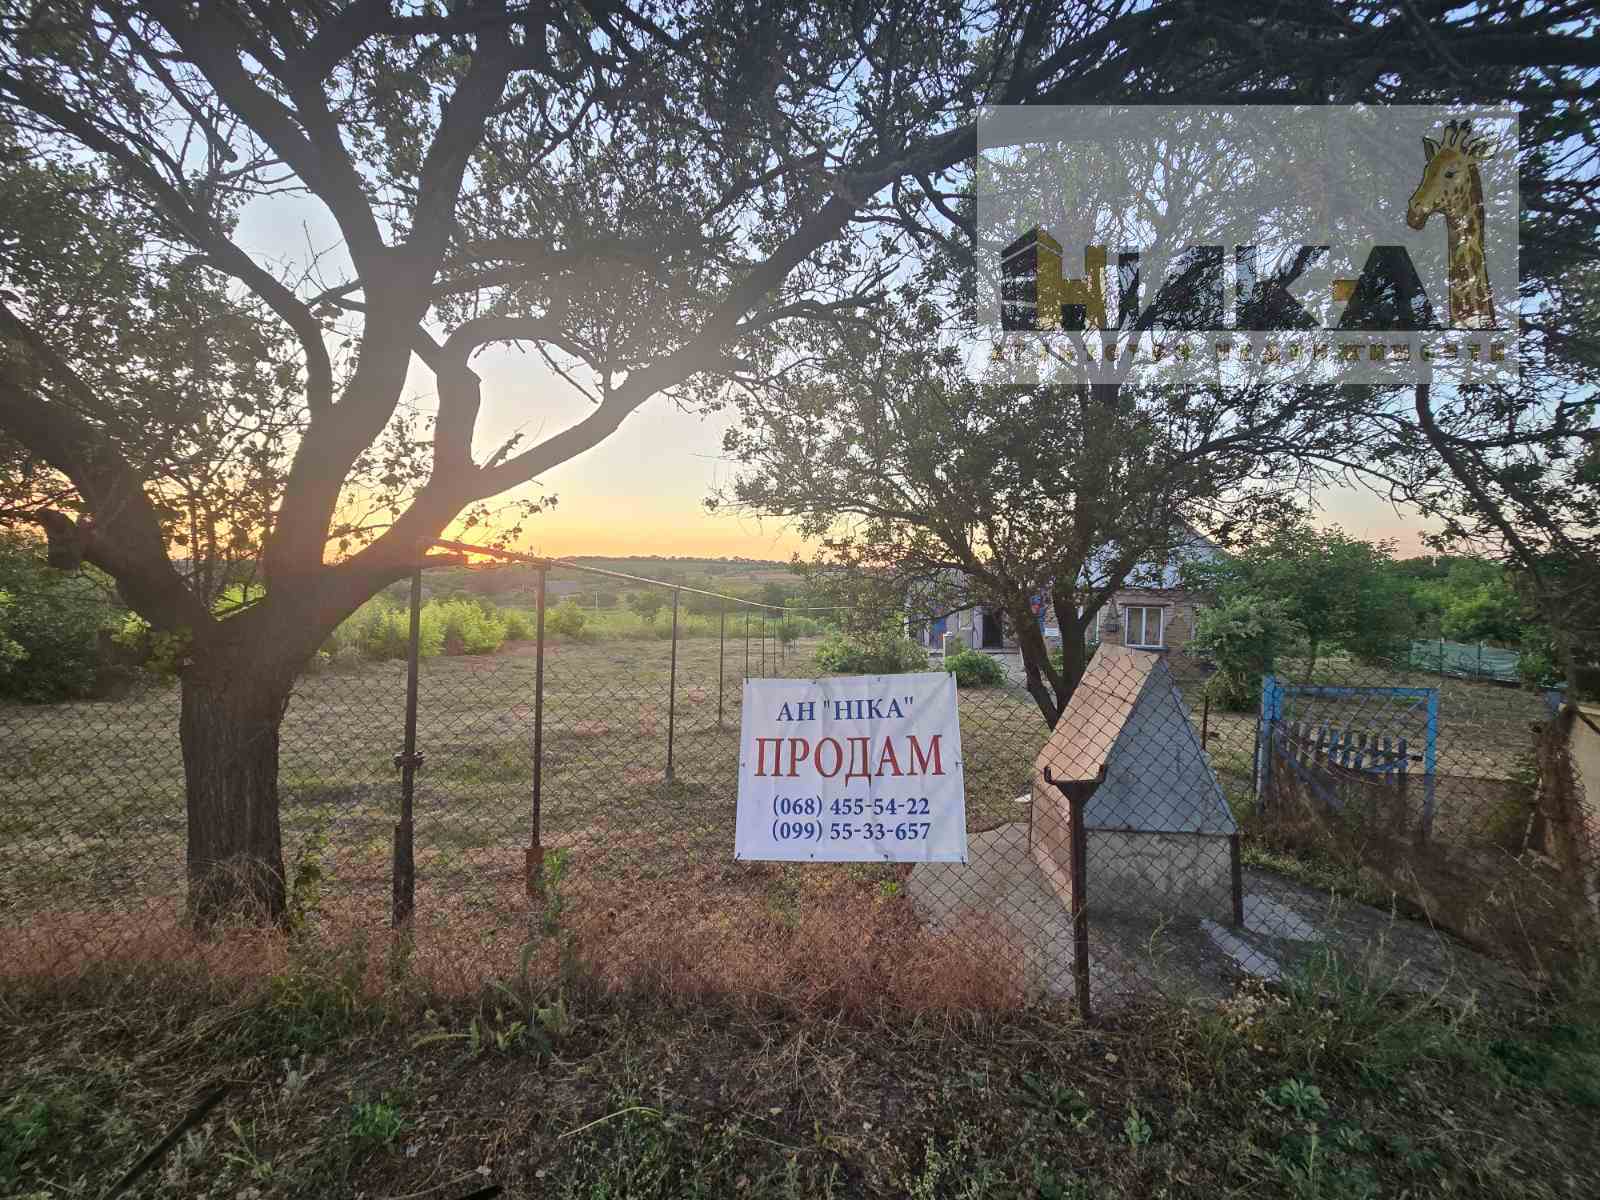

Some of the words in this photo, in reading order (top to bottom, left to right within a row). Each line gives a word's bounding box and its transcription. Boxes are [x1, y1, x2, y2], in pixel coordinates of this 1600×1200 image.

[776, 701, 816, 721] АН
[754, 734, 946, 788] ПРОДАМ
[772, 795, 822, 817] (068)
[830, 798, 930, 815] 455-54-22
[772, 819, 822, 841] (099)
[830, 822, 931, 840] 55-33-657
